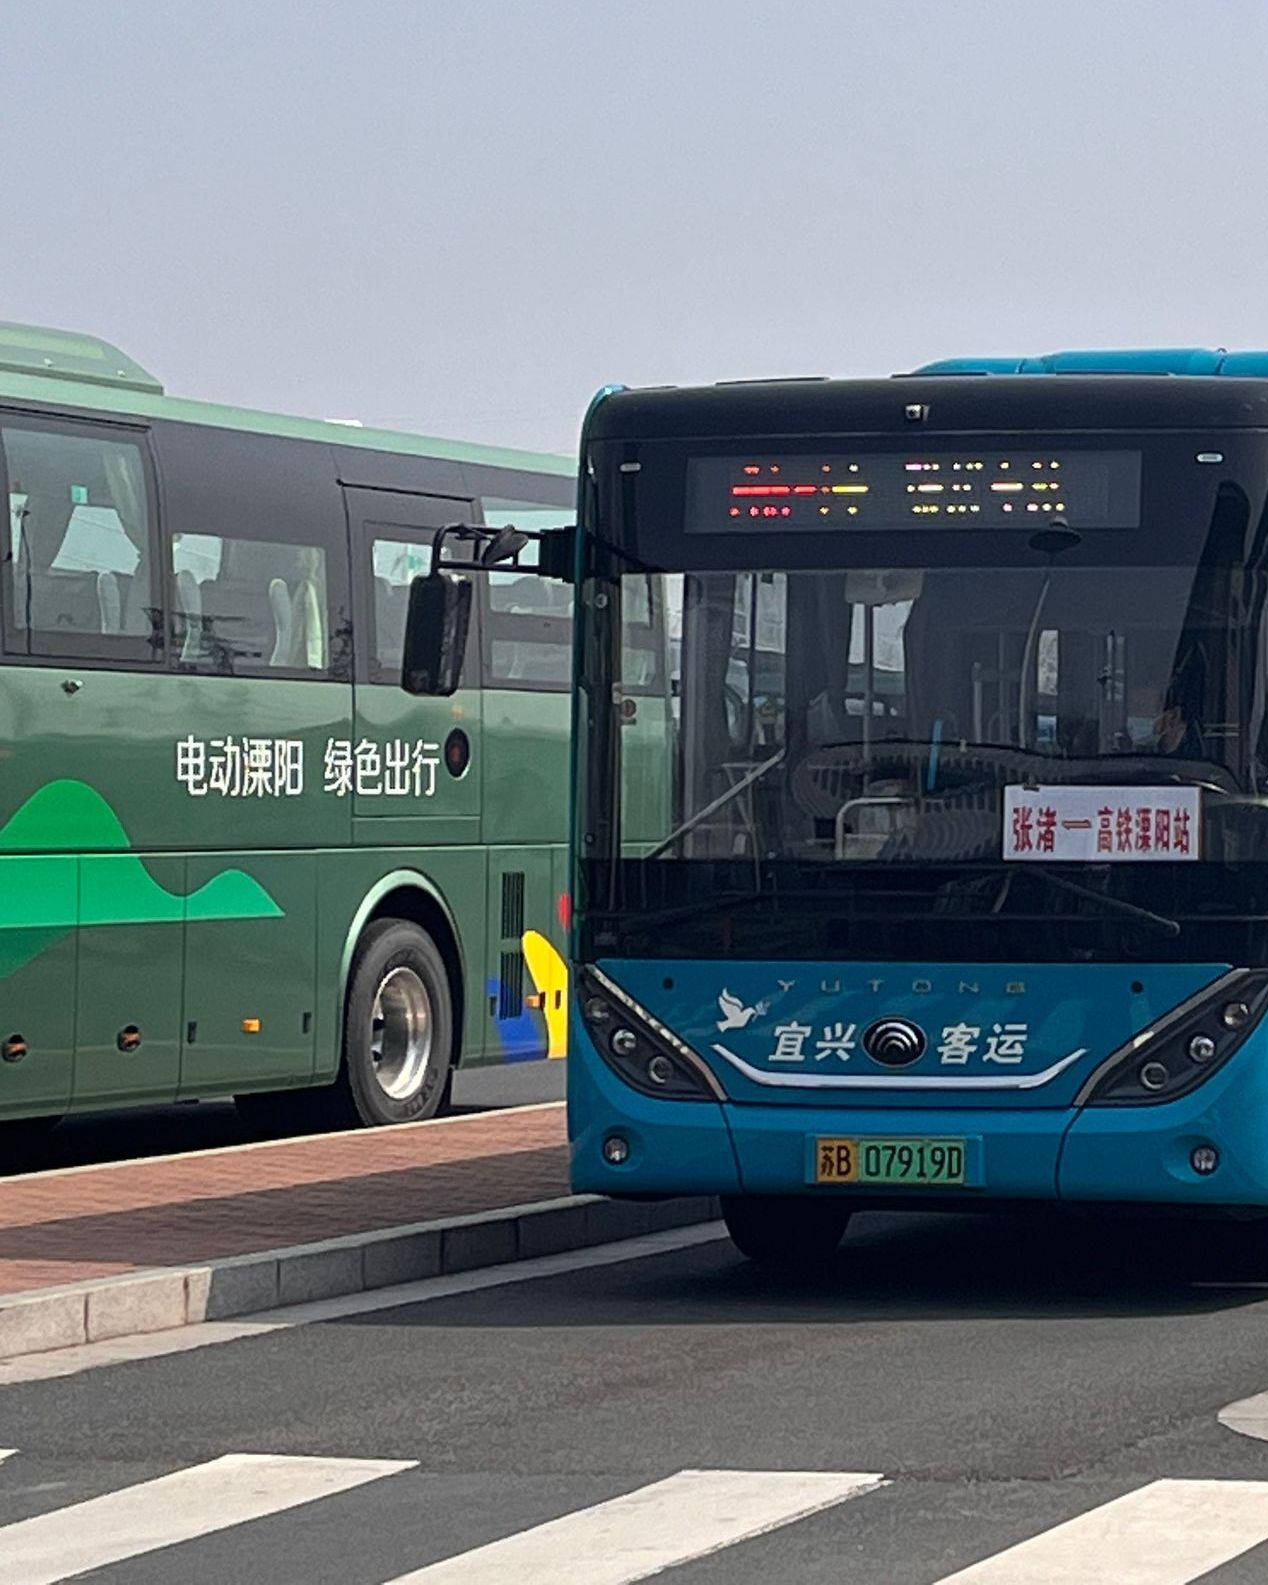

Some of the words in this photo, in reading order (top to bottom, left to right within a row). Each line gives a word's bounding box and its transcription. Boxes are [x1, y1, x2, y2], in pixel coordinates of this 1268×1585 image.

[176, 735, 303, 796] 电动溧阳
[323, 737, 440, 796] 绿色出行
[777, 979, 1026, 993] YUTONG
[768, 1021, 856, 1062] 宜兴
[936, 1022, 1028, 1064] 客运
[865, 1145, 962, 1178] 07919D
